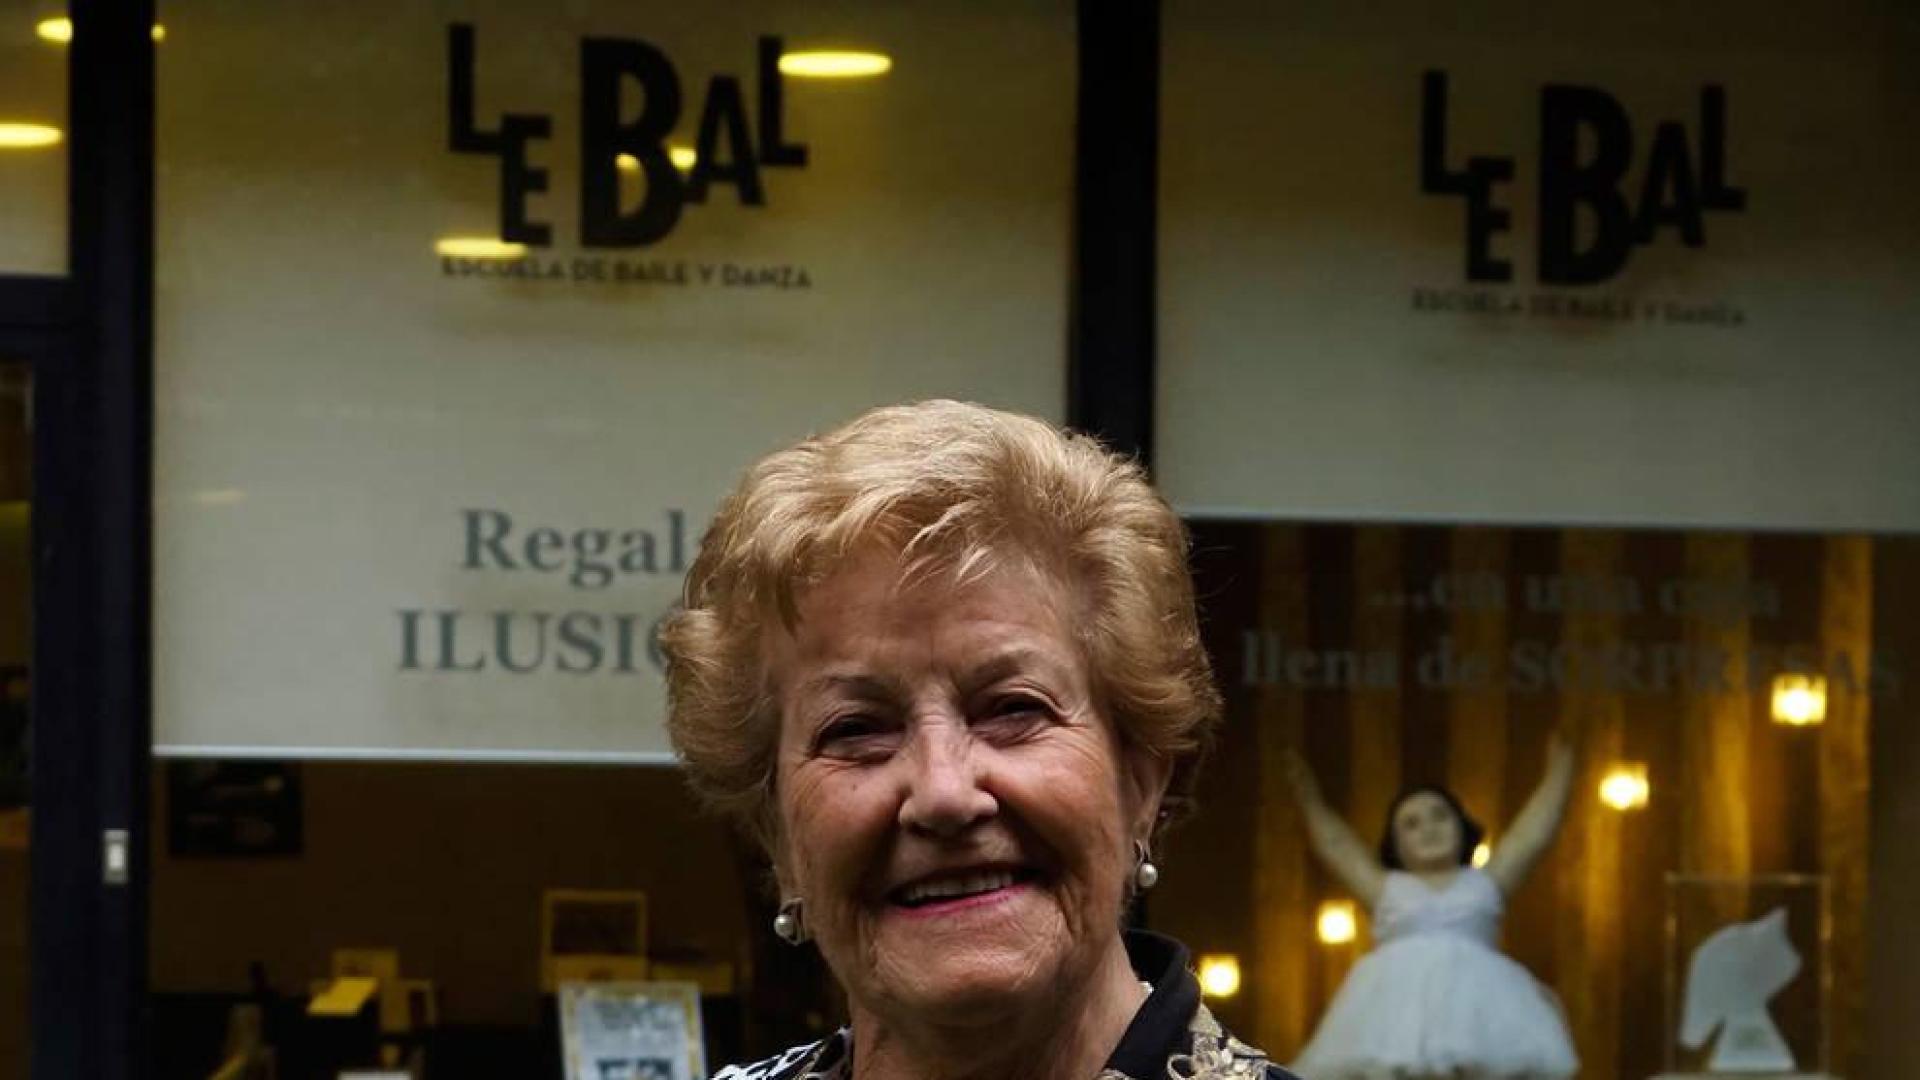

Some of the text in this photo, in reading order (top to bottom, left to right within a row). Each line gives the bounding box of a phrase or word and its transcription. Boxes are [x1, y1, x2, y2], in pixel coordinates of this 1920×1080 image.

[449, 24, 808, 247] LE BAL
[1422, 71, 1746, 285] LE BAL
[573, 258, 607, 281] DE
[613, 260, 686, 285] BAILE
[698, 263, 716, 284] Y
[722, 264, 812, 289] DANZA
[461, 509, 700, 588] Regal
[1241, 630, 1399, 687] llena
[1417, 634, 1492, 690] de
